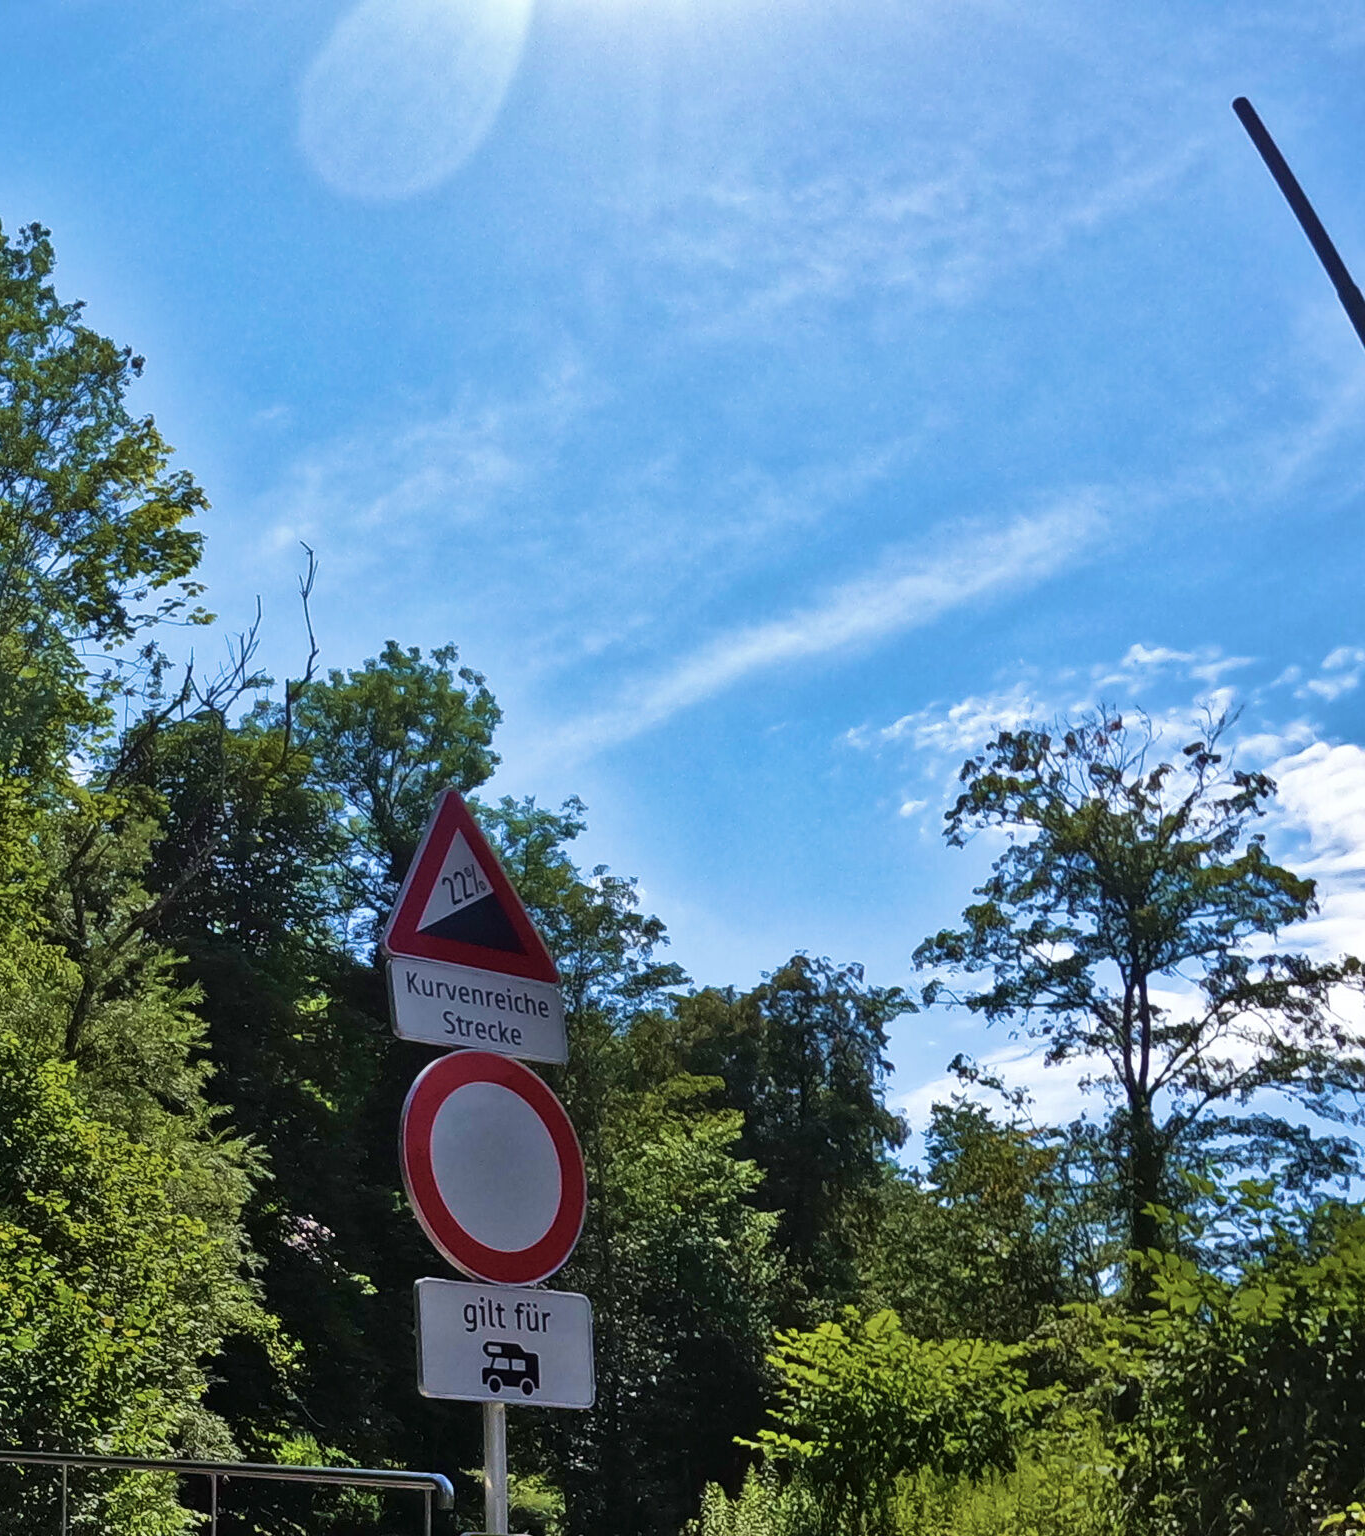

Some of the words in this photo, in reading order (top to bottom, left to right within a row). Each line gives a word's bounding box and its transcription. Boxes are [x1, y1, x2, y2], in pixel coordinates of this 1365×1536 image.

[441, 863, 487, 906] 22%
[405, 970, 550, 1018] Kurvenreiche
[442, 1010, 522, 1046] Strecke
[463, 1296, 507, 1333] gilt
[514, 1302, 551, 1333] für
